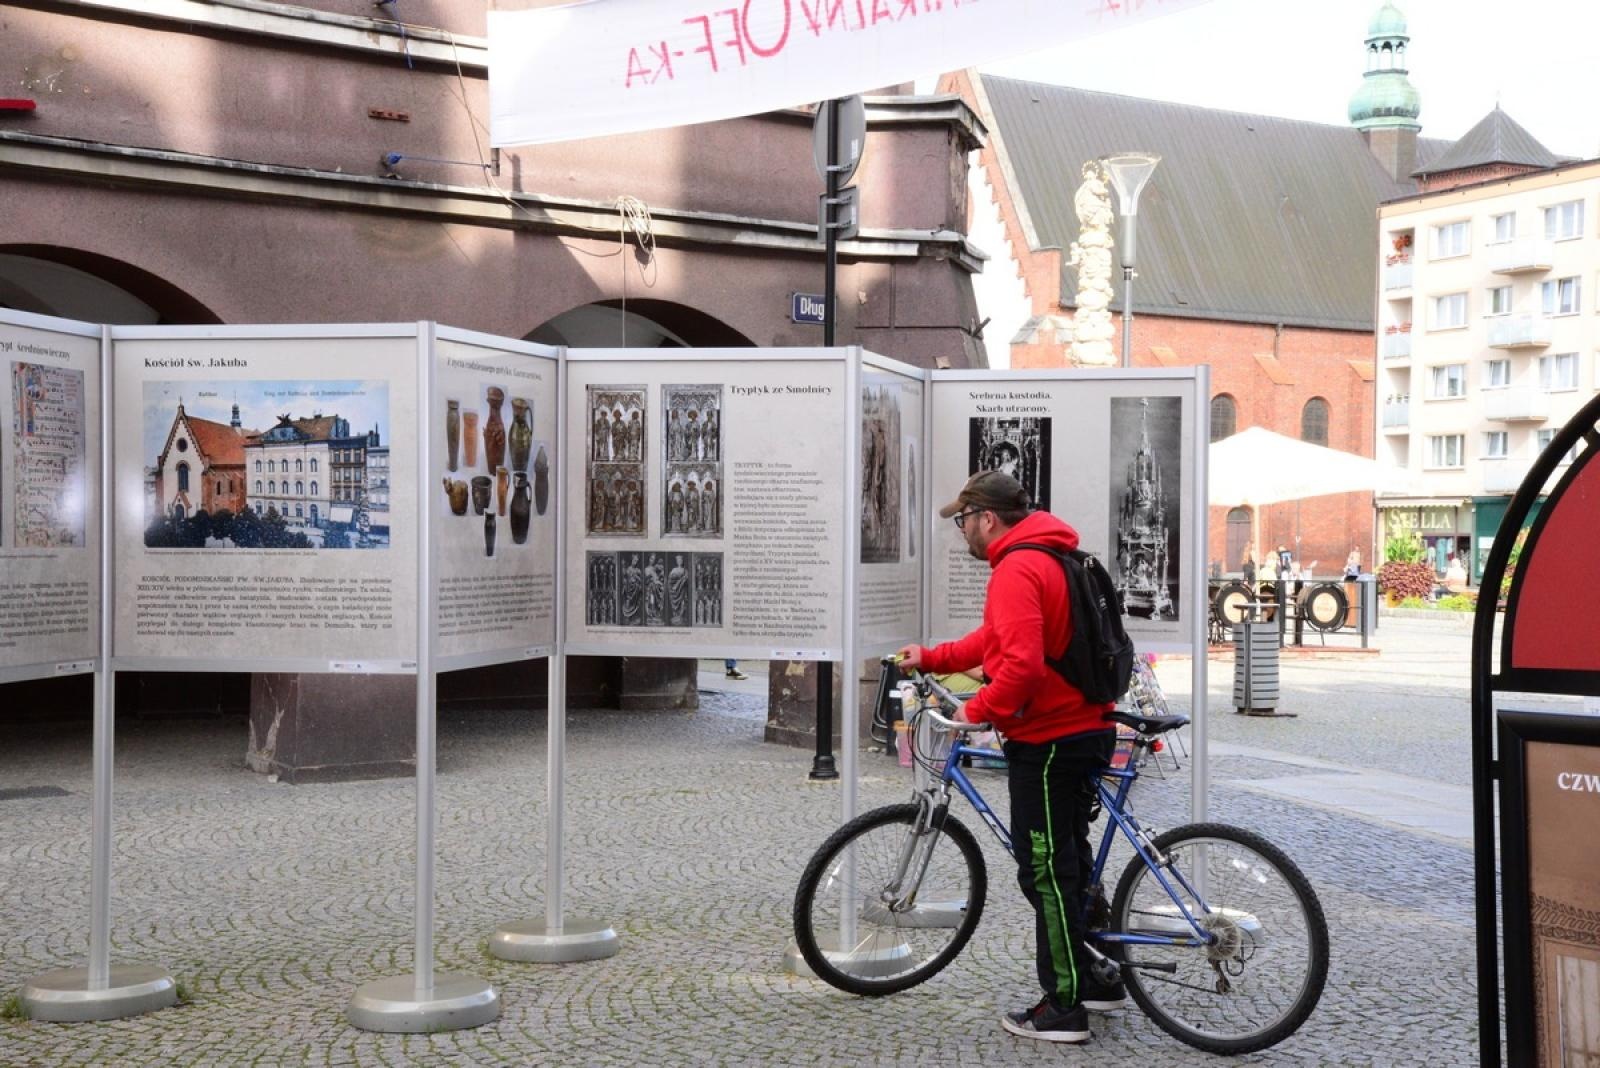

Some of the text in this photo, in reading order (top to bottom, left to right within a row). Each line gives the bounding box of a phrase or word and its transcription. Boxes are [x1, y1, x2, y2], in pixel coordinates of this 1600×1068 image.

[801, 297, 825, 321] Dług
[144, 357, 248, 368] Kościół św. Jakuba
[730, 385, 769, 396] Tryptyk
[786, 385, 832, 396] Smolnicy
[969, 391, 1052, 400] Srebrna kustodia.
[1006, 405, 1050, 414] utracony.
[1558, 772, 1600, 793] CZW
